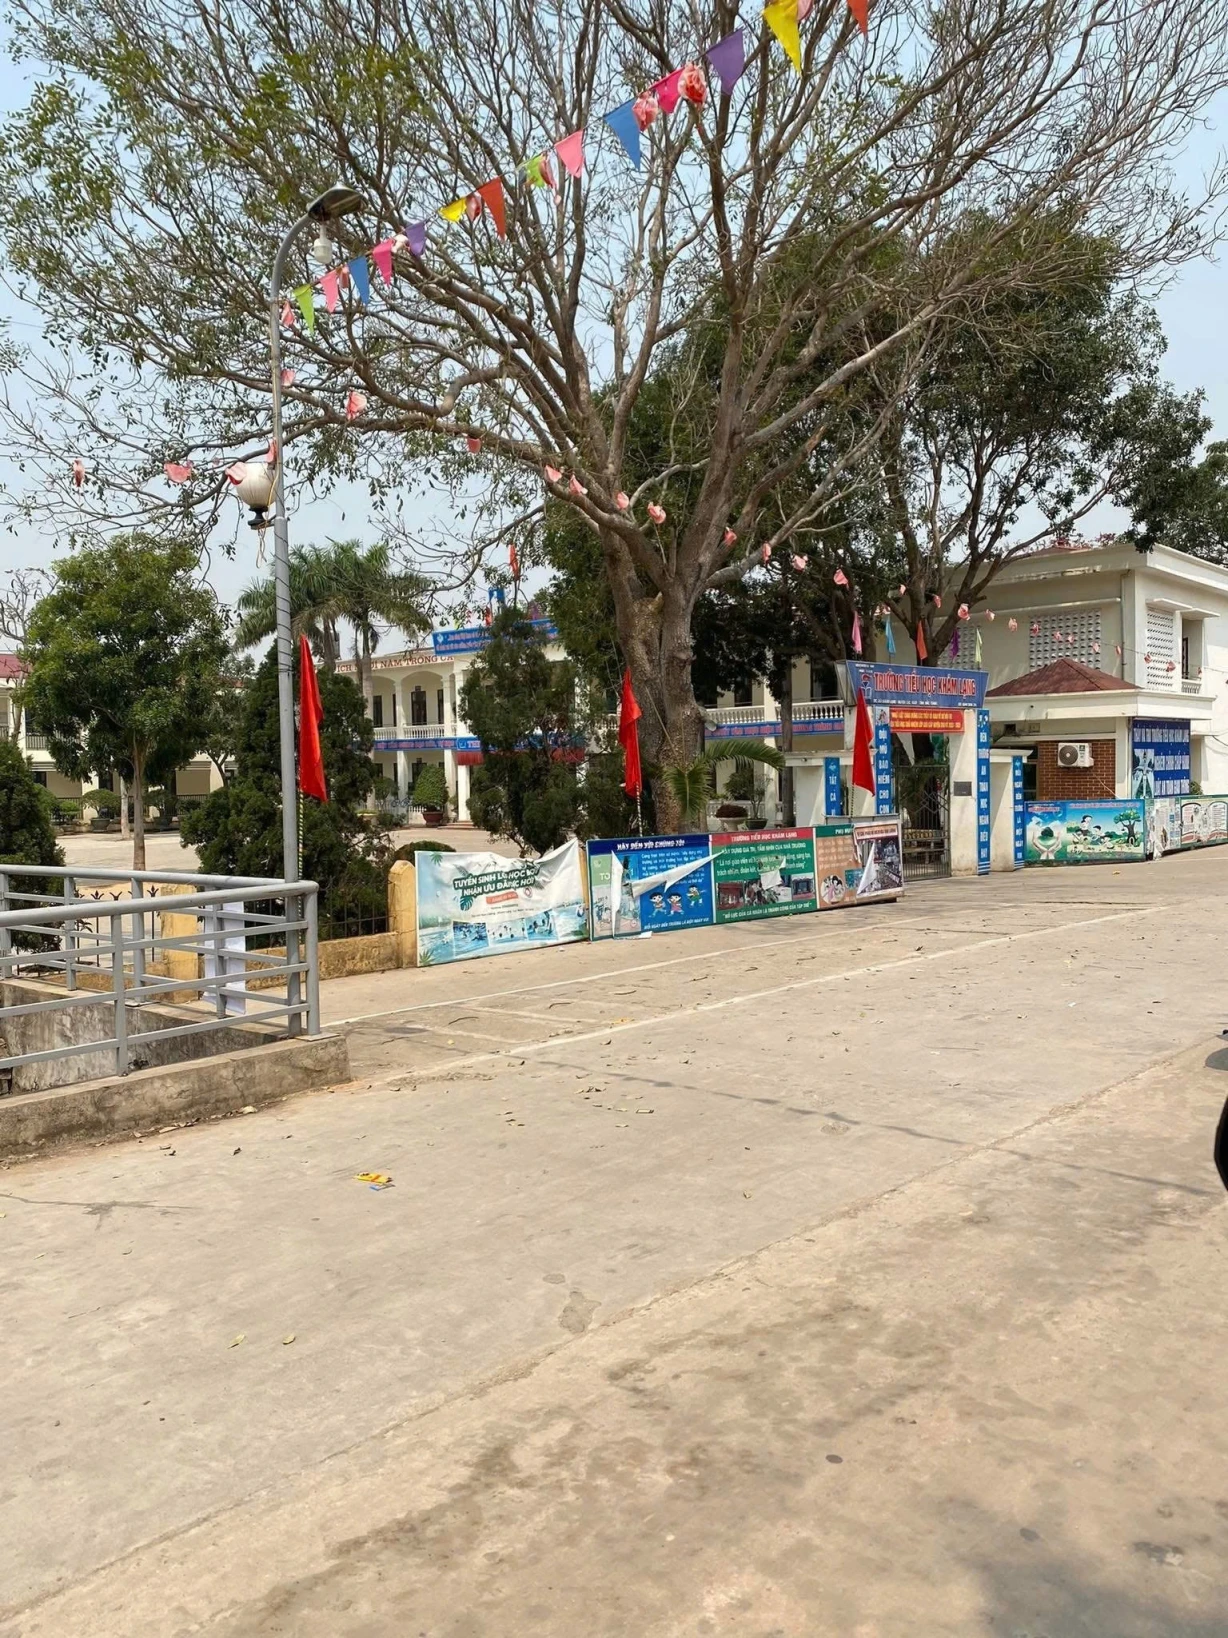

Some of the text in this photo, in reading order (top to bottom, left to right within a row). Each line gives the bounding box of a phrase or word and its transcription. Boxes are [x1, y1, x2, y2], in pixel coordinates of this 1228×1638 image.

[874, 668, 904, 692] TRƯỜNG
[905, 668, 921, 694] TIỂU
[922, 675, 937, 697] HỌC
[937, 674, 958, 696] KHÁM
[959, 678, 976, 699] LẠNG
[879, 790, 889, 799] CHO
[879, 805, 889, 814] CON
[454, 875, 477, 888] TUYỂN
[478, 873, 496, 884] SINH
[508, 870, 526, 880] HỌC
[463, 886, 483, 897] NHẬN
[483, 882, 495, 892] ƯU
